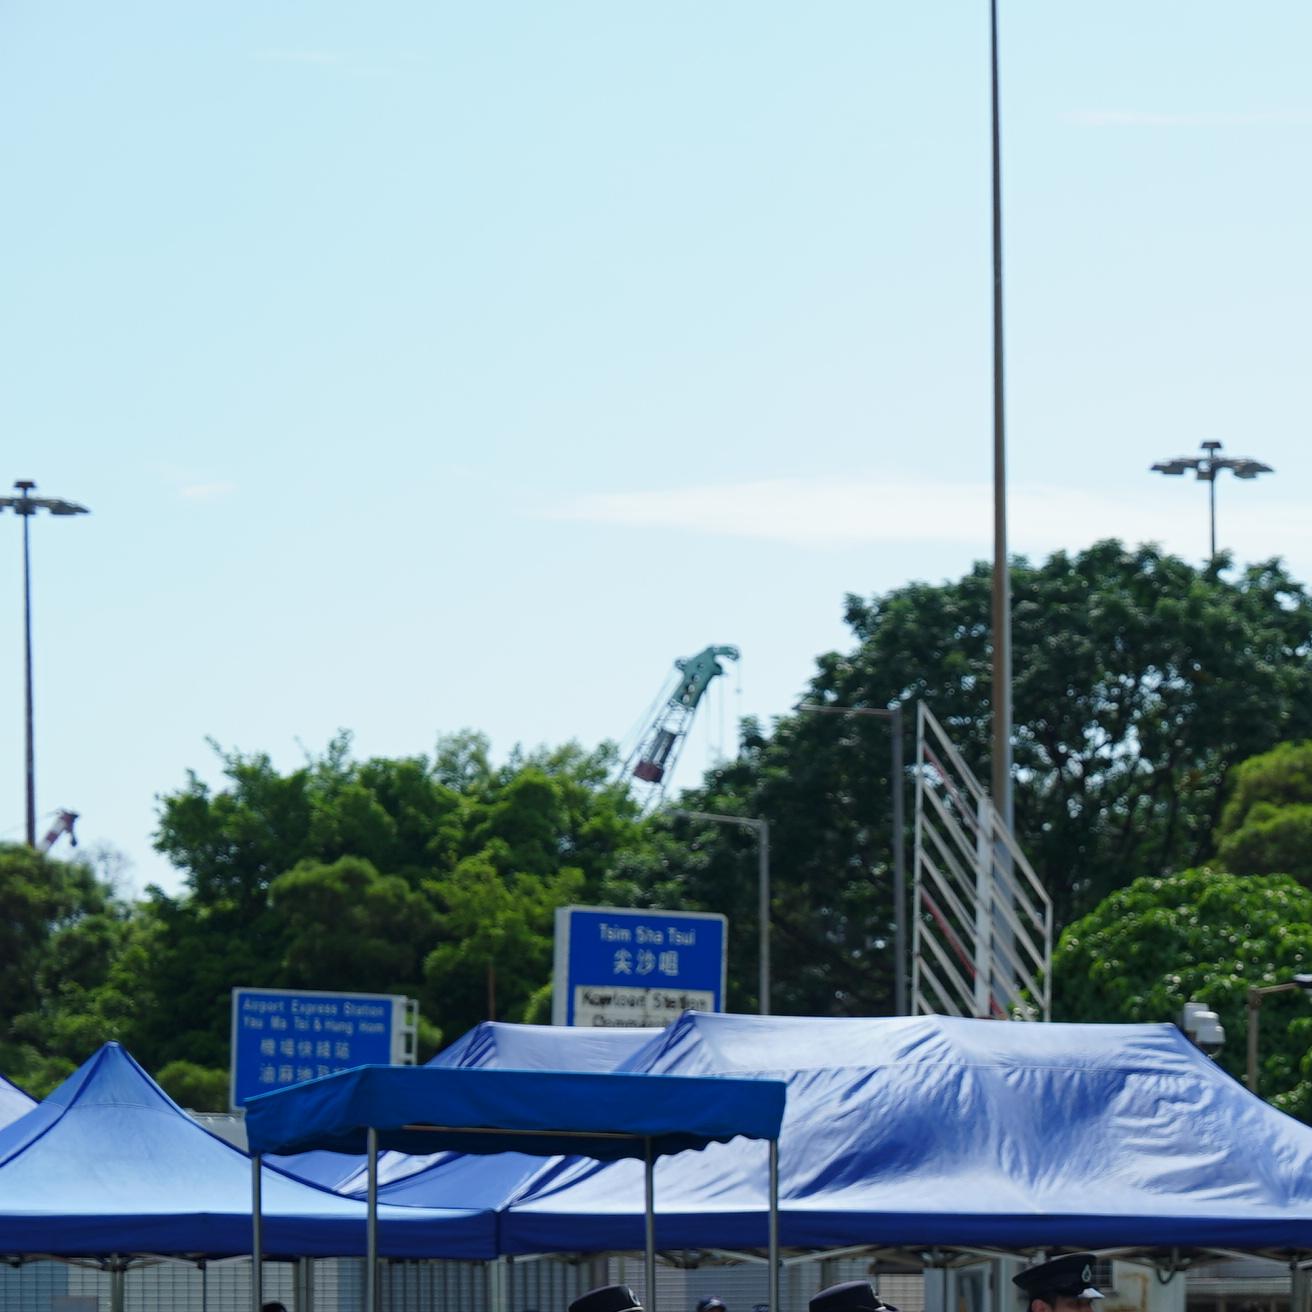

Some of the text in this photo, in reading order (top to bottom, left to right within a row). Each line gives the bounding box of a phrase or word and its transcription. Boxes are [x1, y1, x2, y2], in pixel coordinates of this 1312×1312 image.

[599, 923, 696, 946] Tsim Sha Tsui
[613, 948, 679, 976] 尖沙咀
[243, 997, 385, 1018] Airport Express Station
